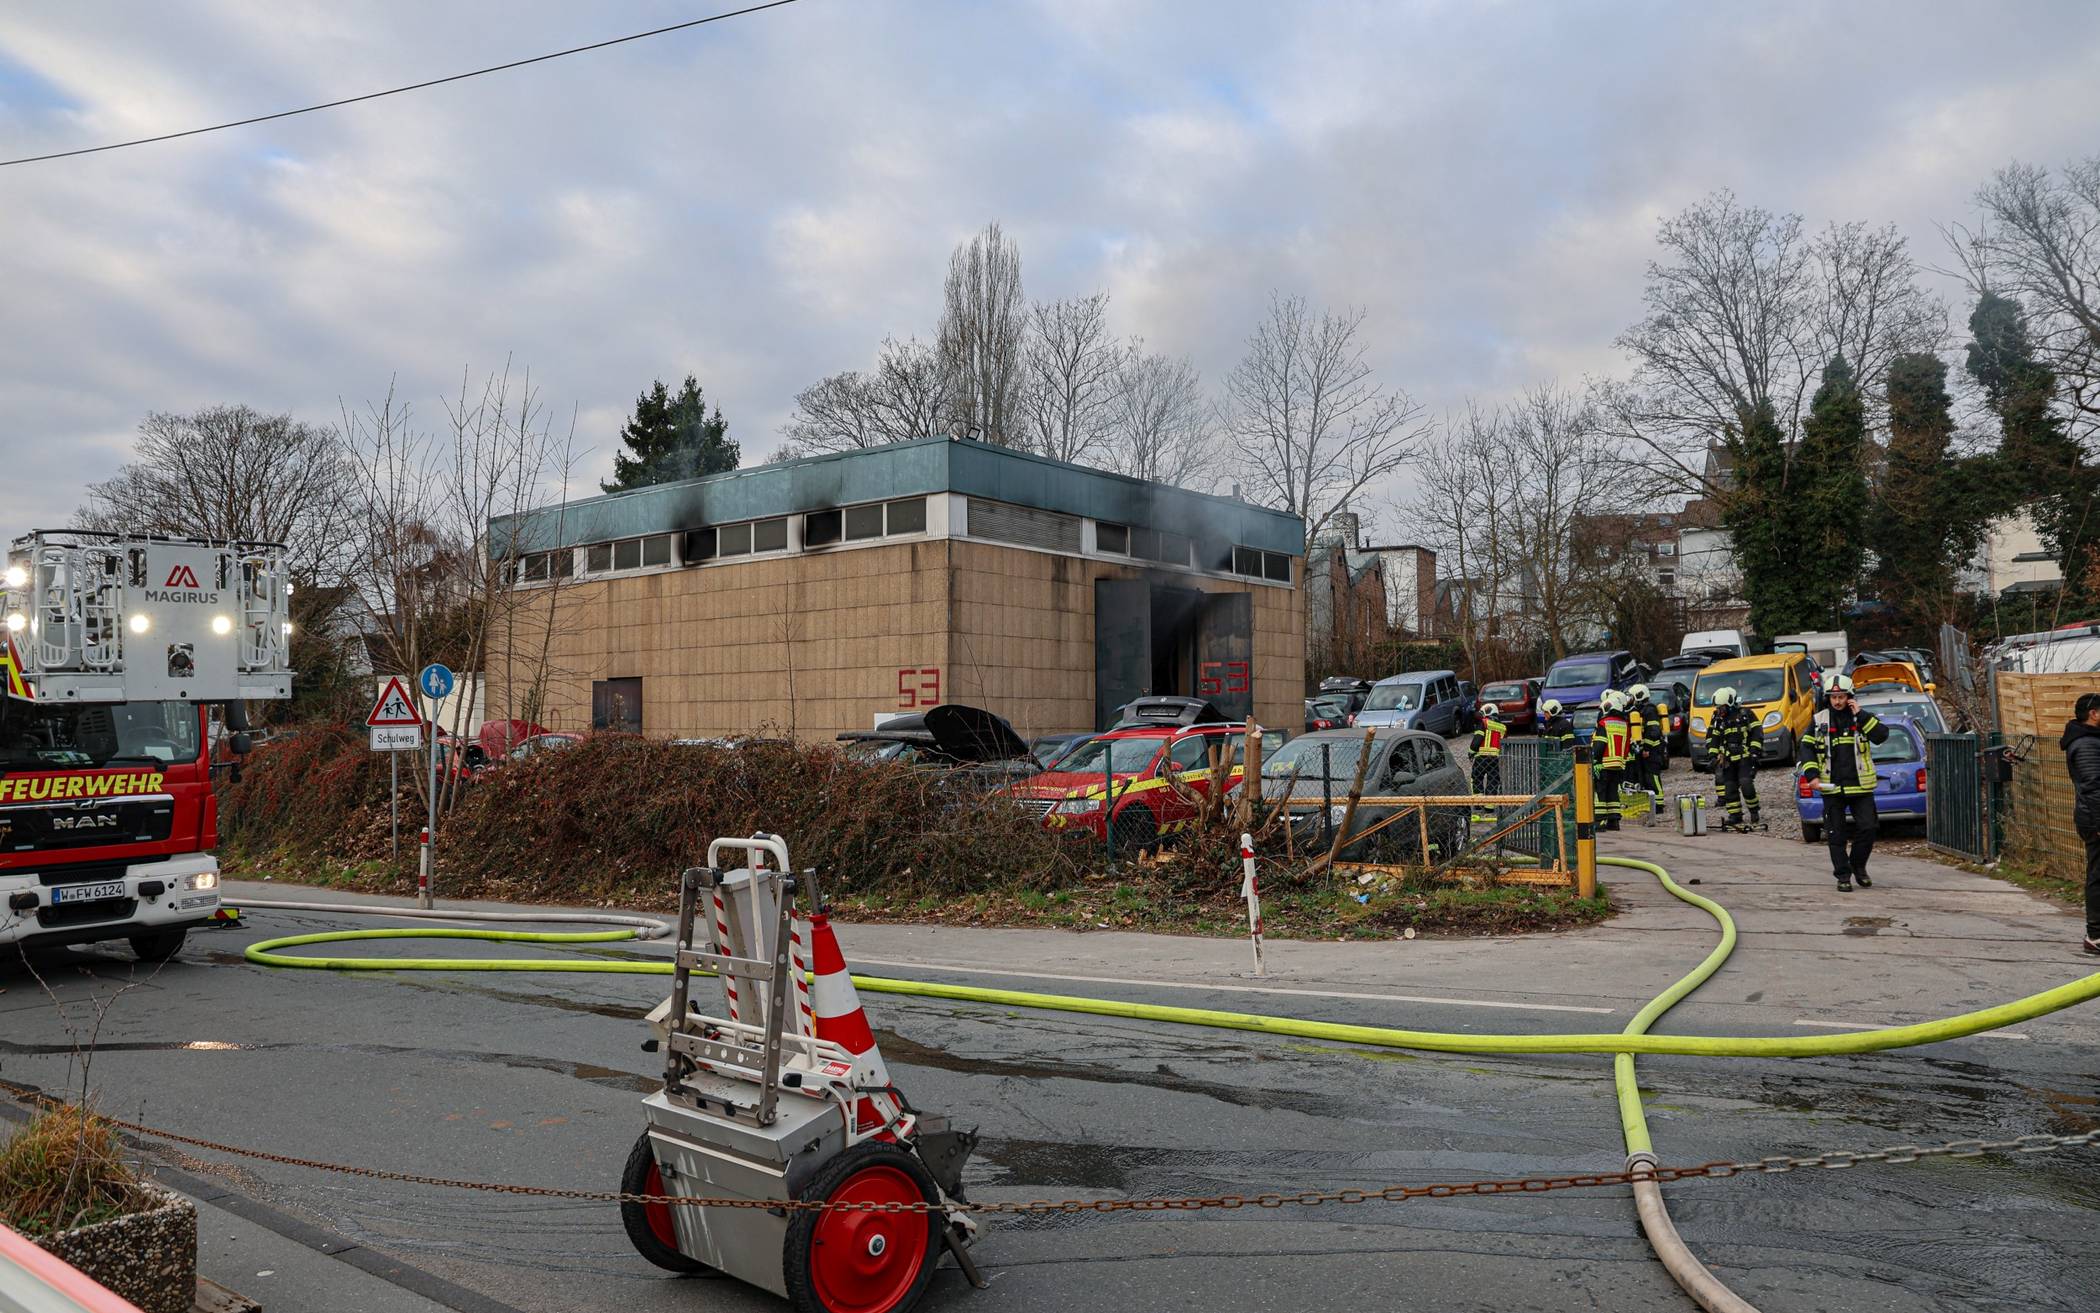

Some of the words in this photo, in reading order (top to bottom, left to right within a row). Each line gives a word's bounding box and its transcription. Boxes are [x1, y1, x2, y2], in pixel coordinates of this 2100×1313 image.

[145, 591, 218, 604] MAGIRUS
[1200, 662, 1248, 695] 53
[899, 669, 939, 707] 53
[377, 732, 415, 744] Schulweg
[0, 773, 164, 800] FEUERWEHR
[53, 814, 117, 830] MAN
[94, 885, 122, 897] 6124
